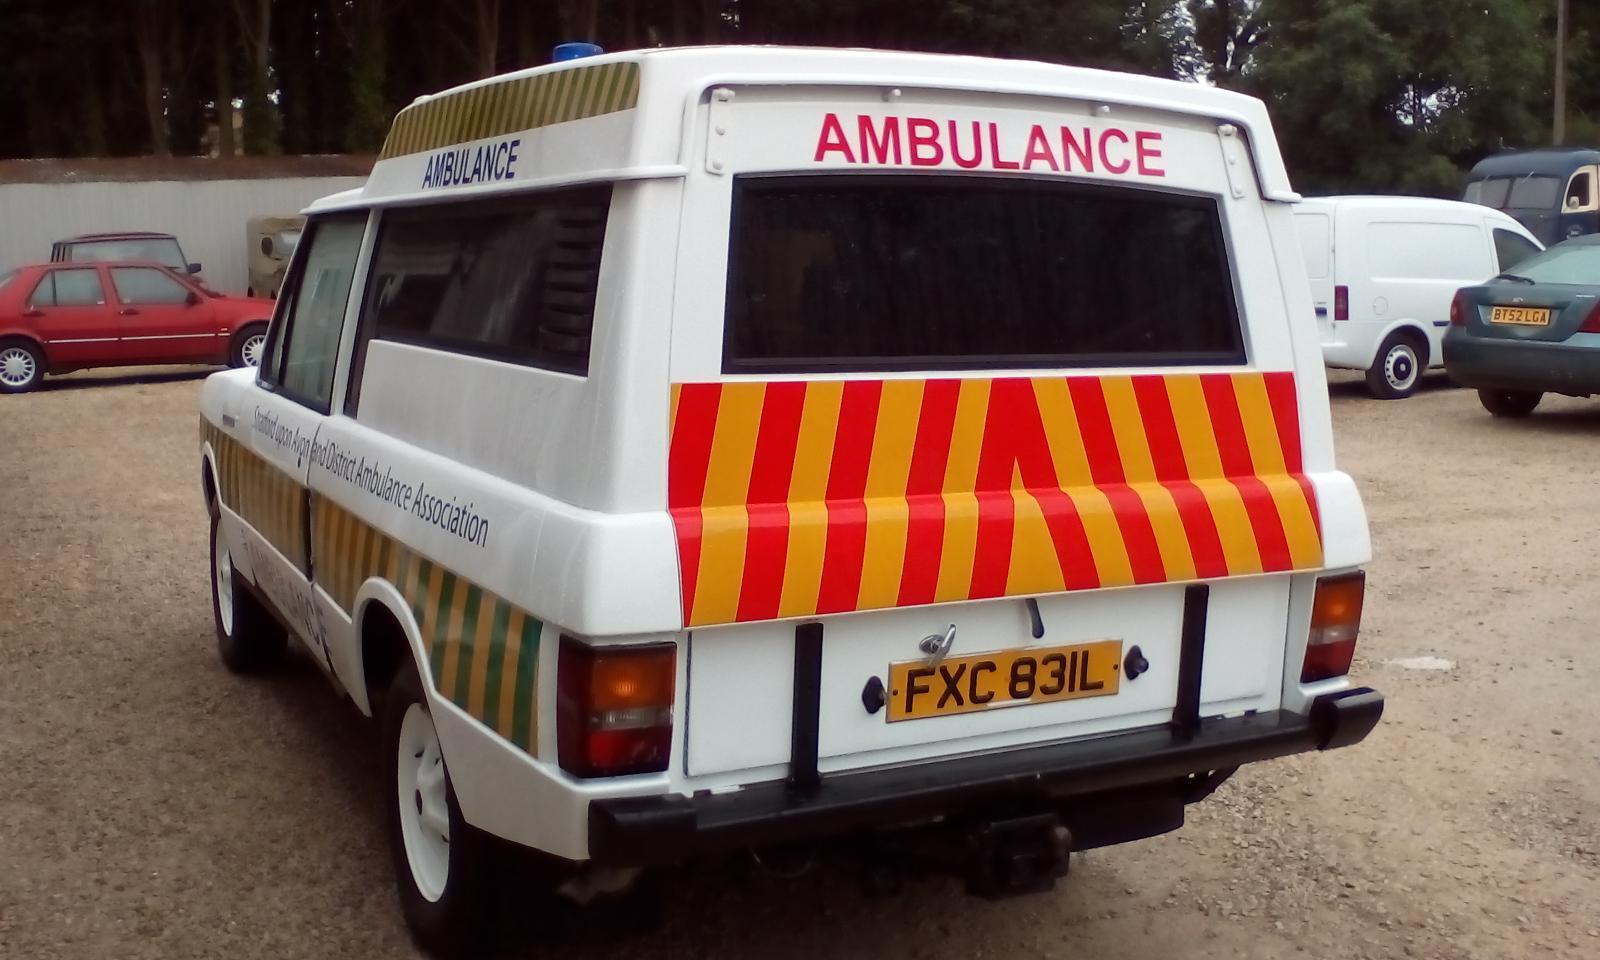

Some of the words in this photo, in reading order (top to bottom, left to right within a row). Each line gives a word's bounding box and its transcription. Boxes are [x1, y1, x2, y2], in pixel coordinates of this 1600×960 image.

[422, 139, 520, 189] AMBULANCE
[814, 113, 1165, 177] AMBULANCE
[1494, 308, 1523, 321] BT52
[1525, 310, 1546, 324] LGA
[275, 424, 293, 448] upon
[326, 441, 356, 482] District
[355, 456, 412, 510] Ambulance
[411, 482, 488, 548] Association
[905, 661, 996, 713] FXC
[1008, 650, 1104, 700] 831L
